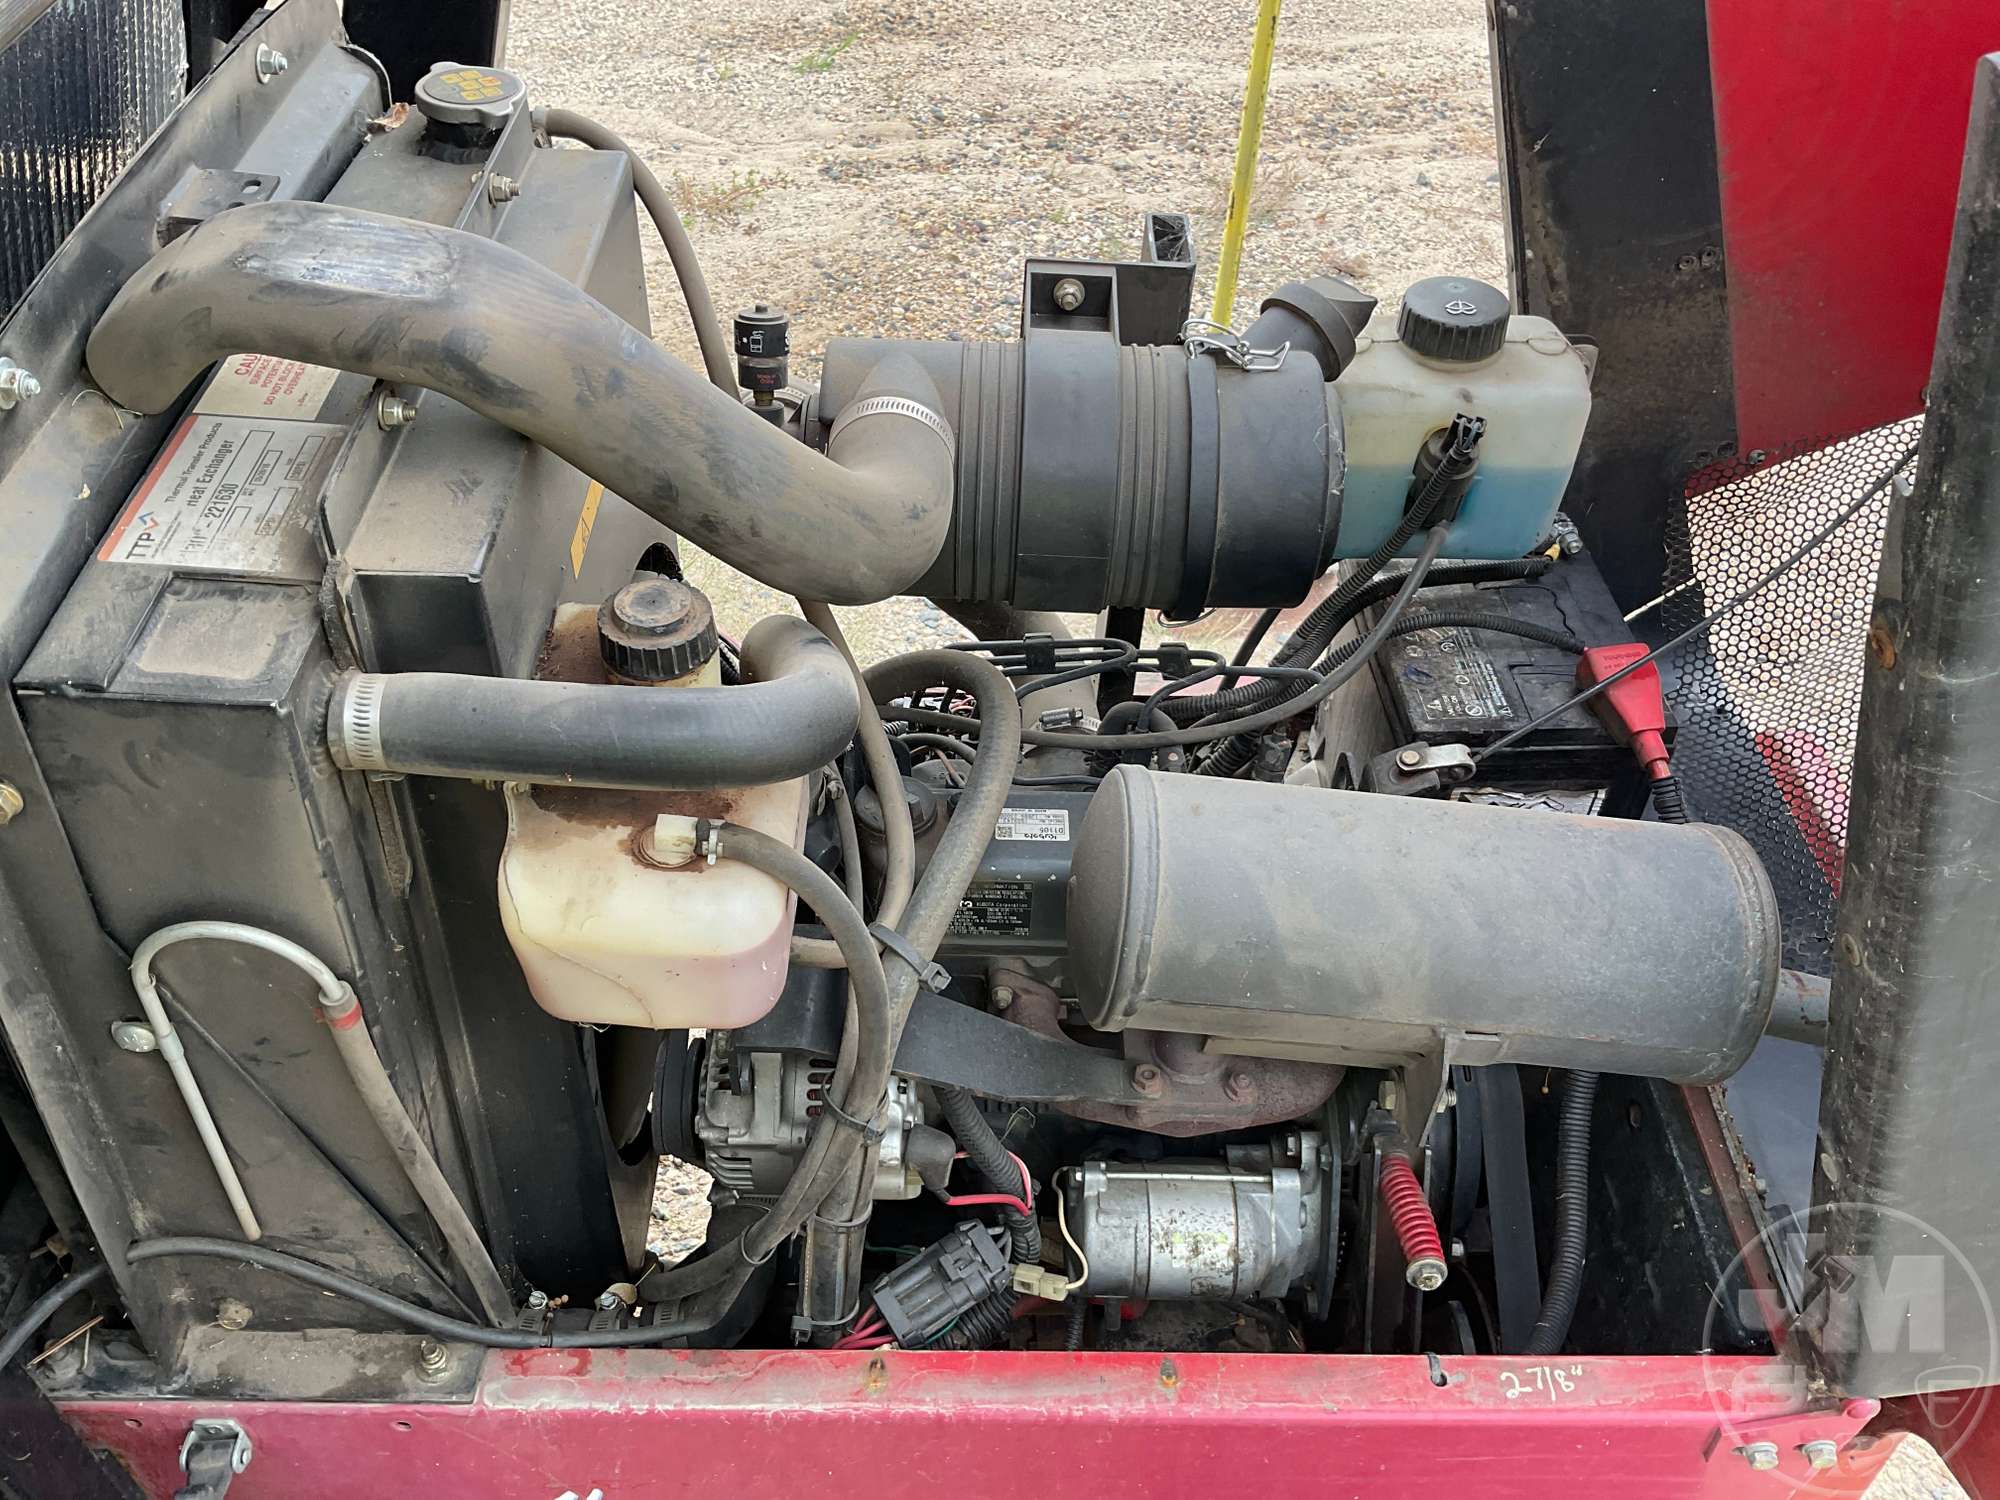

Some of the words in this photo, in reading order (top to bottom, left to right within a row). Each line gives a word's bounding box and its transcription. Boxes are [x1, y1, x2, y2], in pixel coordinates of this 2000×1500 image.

[164, 476, 188, 503] Thermal
[182, 447, 204, 476] Transfer
[198, 422, 223, 450] Products
[197, 439, 234, 484] Exchanger
[204, 483, 239, 519] 221630
[125, 532, 156, 560] TTP
[1500, 1371, 1533, 1399] 2
